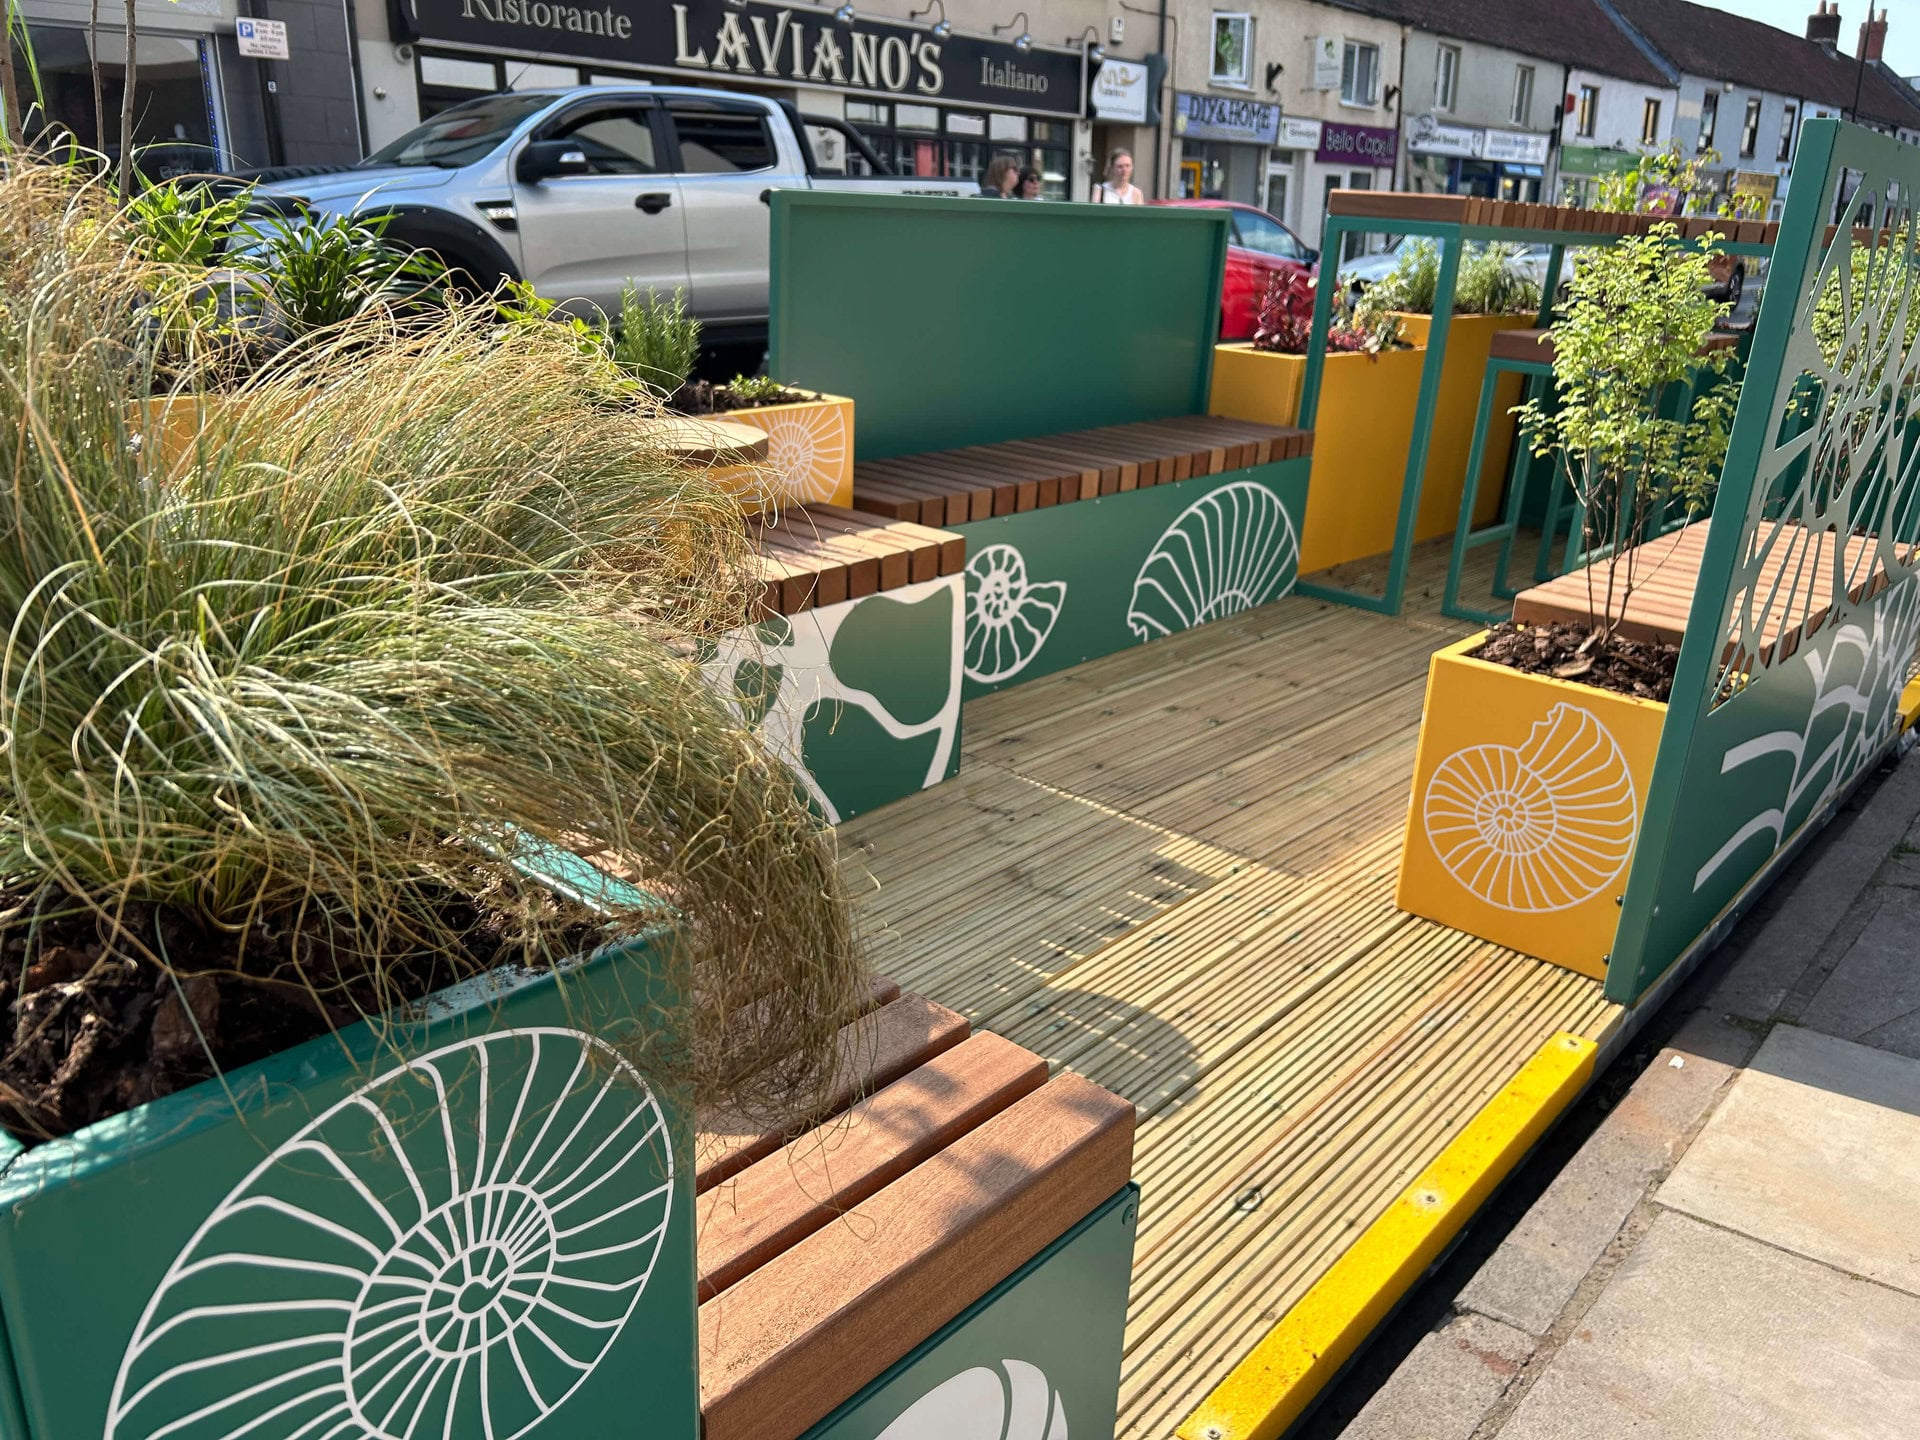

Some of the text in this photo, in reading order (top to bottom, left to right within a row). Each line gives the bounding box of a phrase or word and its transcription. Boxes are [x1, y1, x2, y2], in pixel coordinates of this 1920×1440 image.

[242, 24, 251, 36] P
[672, 4, 944, 95] LAVIANO'S
[980, 56, 1049, 93] Italiano
